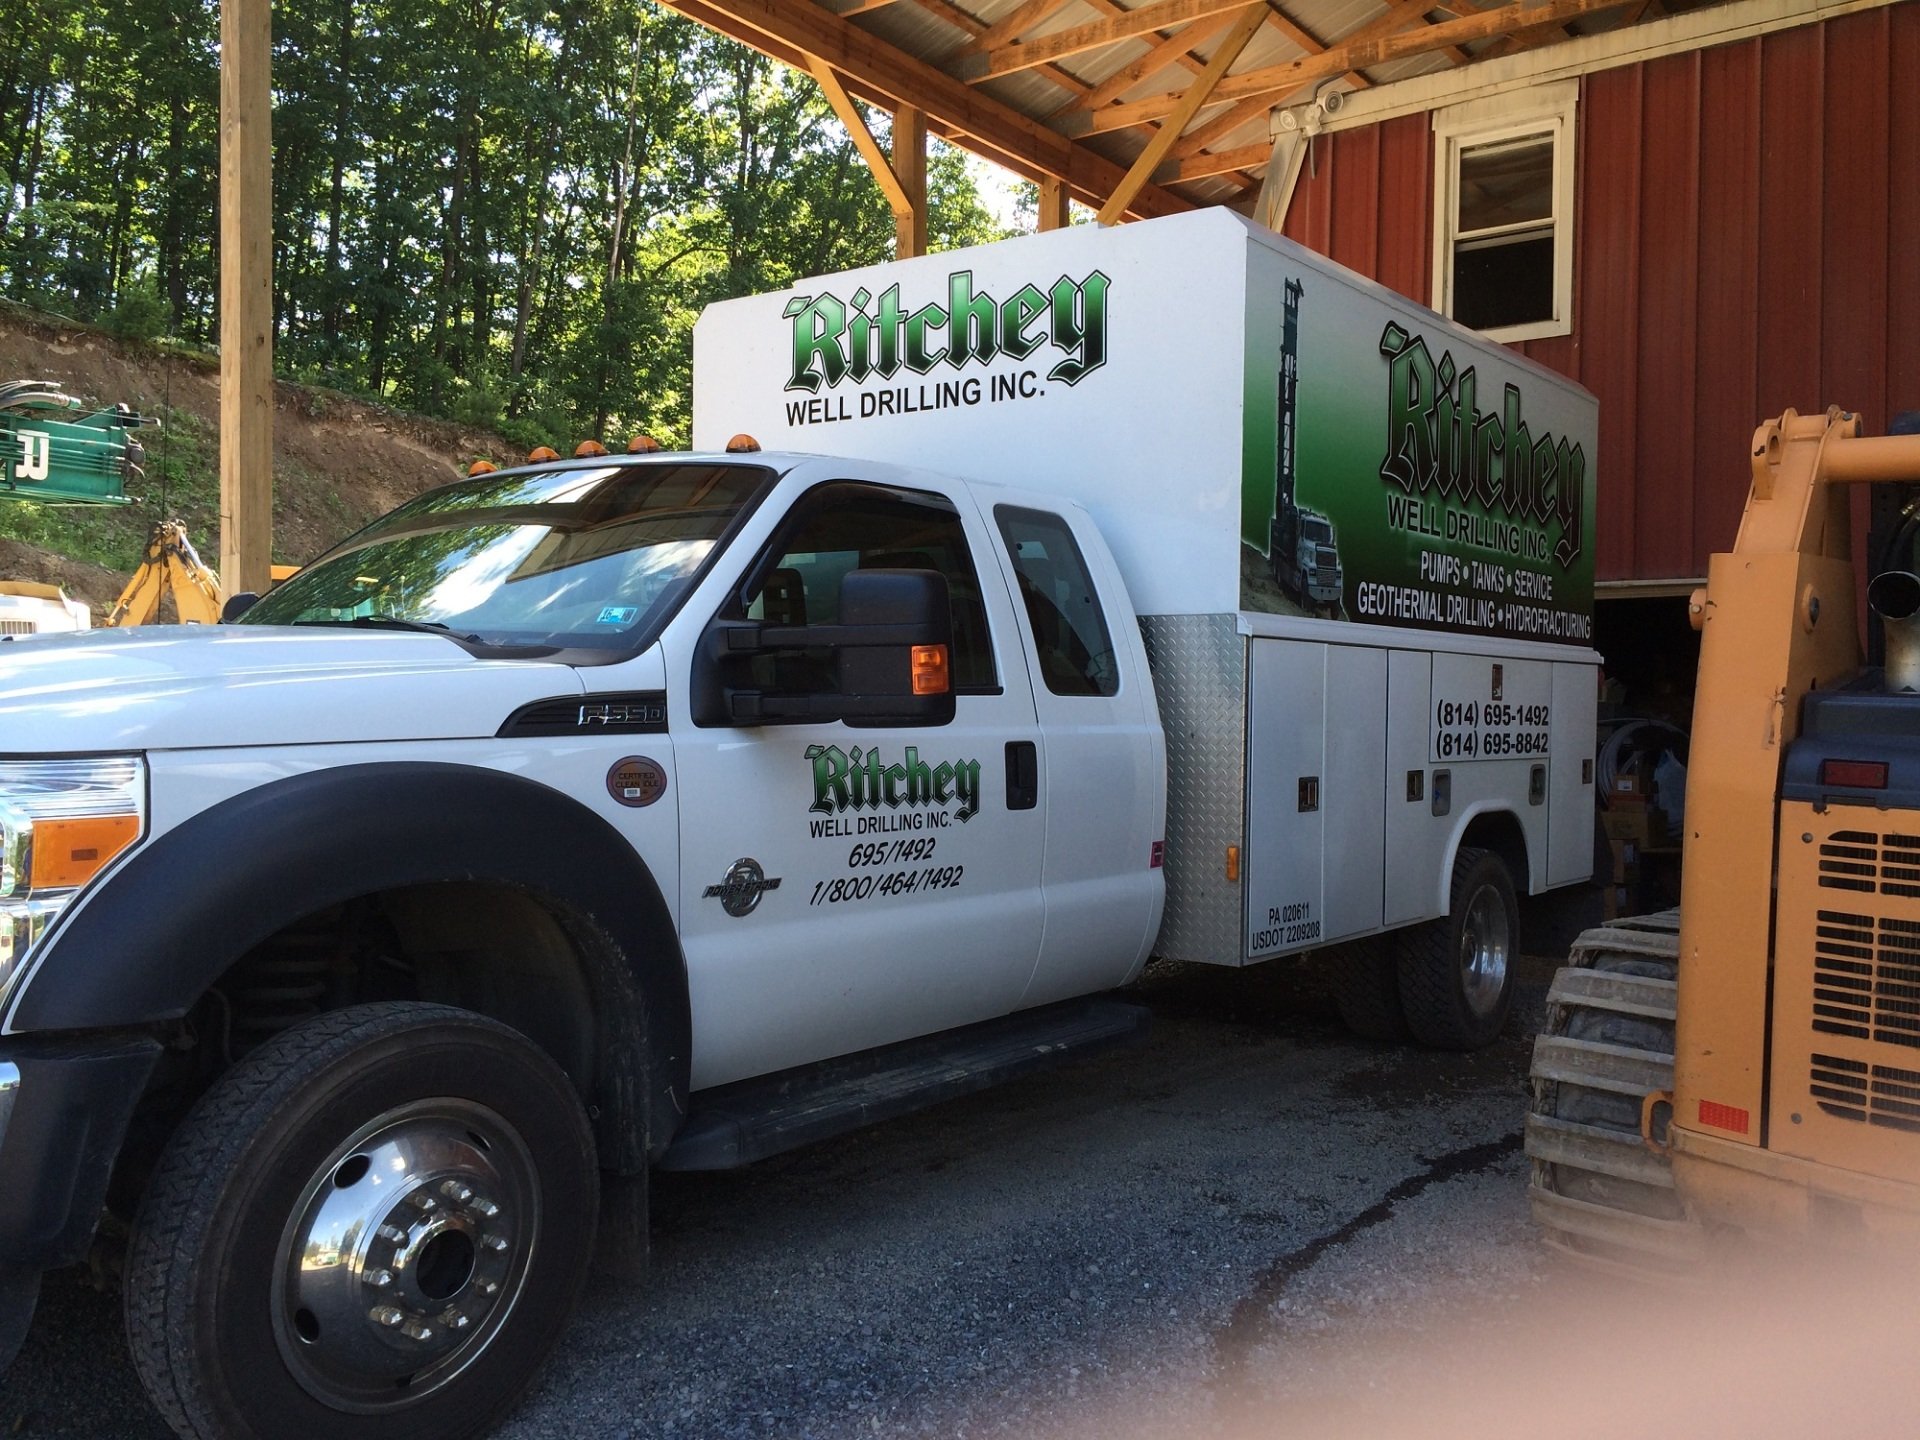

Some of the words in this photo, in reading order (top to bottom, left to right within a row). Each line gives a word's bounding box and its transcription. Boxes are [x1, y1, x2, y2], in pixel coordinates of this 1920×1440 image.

[783, 269, 1112, 394] Ritchey
[786, 396, 853, 426] WELL
[860, 378, 981, 418] DRILLING
[991, 370, 1045, 402] INC.
[1379, 320, 1585, 569] Ritchey
[1388, 494, 1441, 537] WELL
[1446, 509, 1519, 553] DRILLING
[1523, 527, 1551, 561] INC.
[1420, 550, 1461, 586] PUMPS
[1471, 561, 1505, 593] TANKS
[1514, 570, 1553, 600] SERVICE
[1357, 581, 1444, 622] GEOTHERMAL
[1446, 597, 1495, 628] DRILLING
[1505, 604, 1591, 639] HYDROFRACTURING
[1436, 699, 1479, 728] (814)
[1484, 704, 1549, 726] 695-1492
[1436, 730, 1479, 759] (814)
[1483, 733, 1549, 754] 695-8842
[804, 744, 982, 824] Ritchey
[810, 818, 853, 838] WELL
[857, 814, 922, 834] DRILLING
[926, 811, 952, 828] INC.
[848, 837, 937, 868] 695/1492
[810, 865, 963, 906] 1/800/464/1492
[1252, 927, 1285, 950] USDOT
[1286, 921, 1320, 943] 2209208
[1268, 907, 1281, 926] PA
[1282, 901, 1310, 923] 020611
